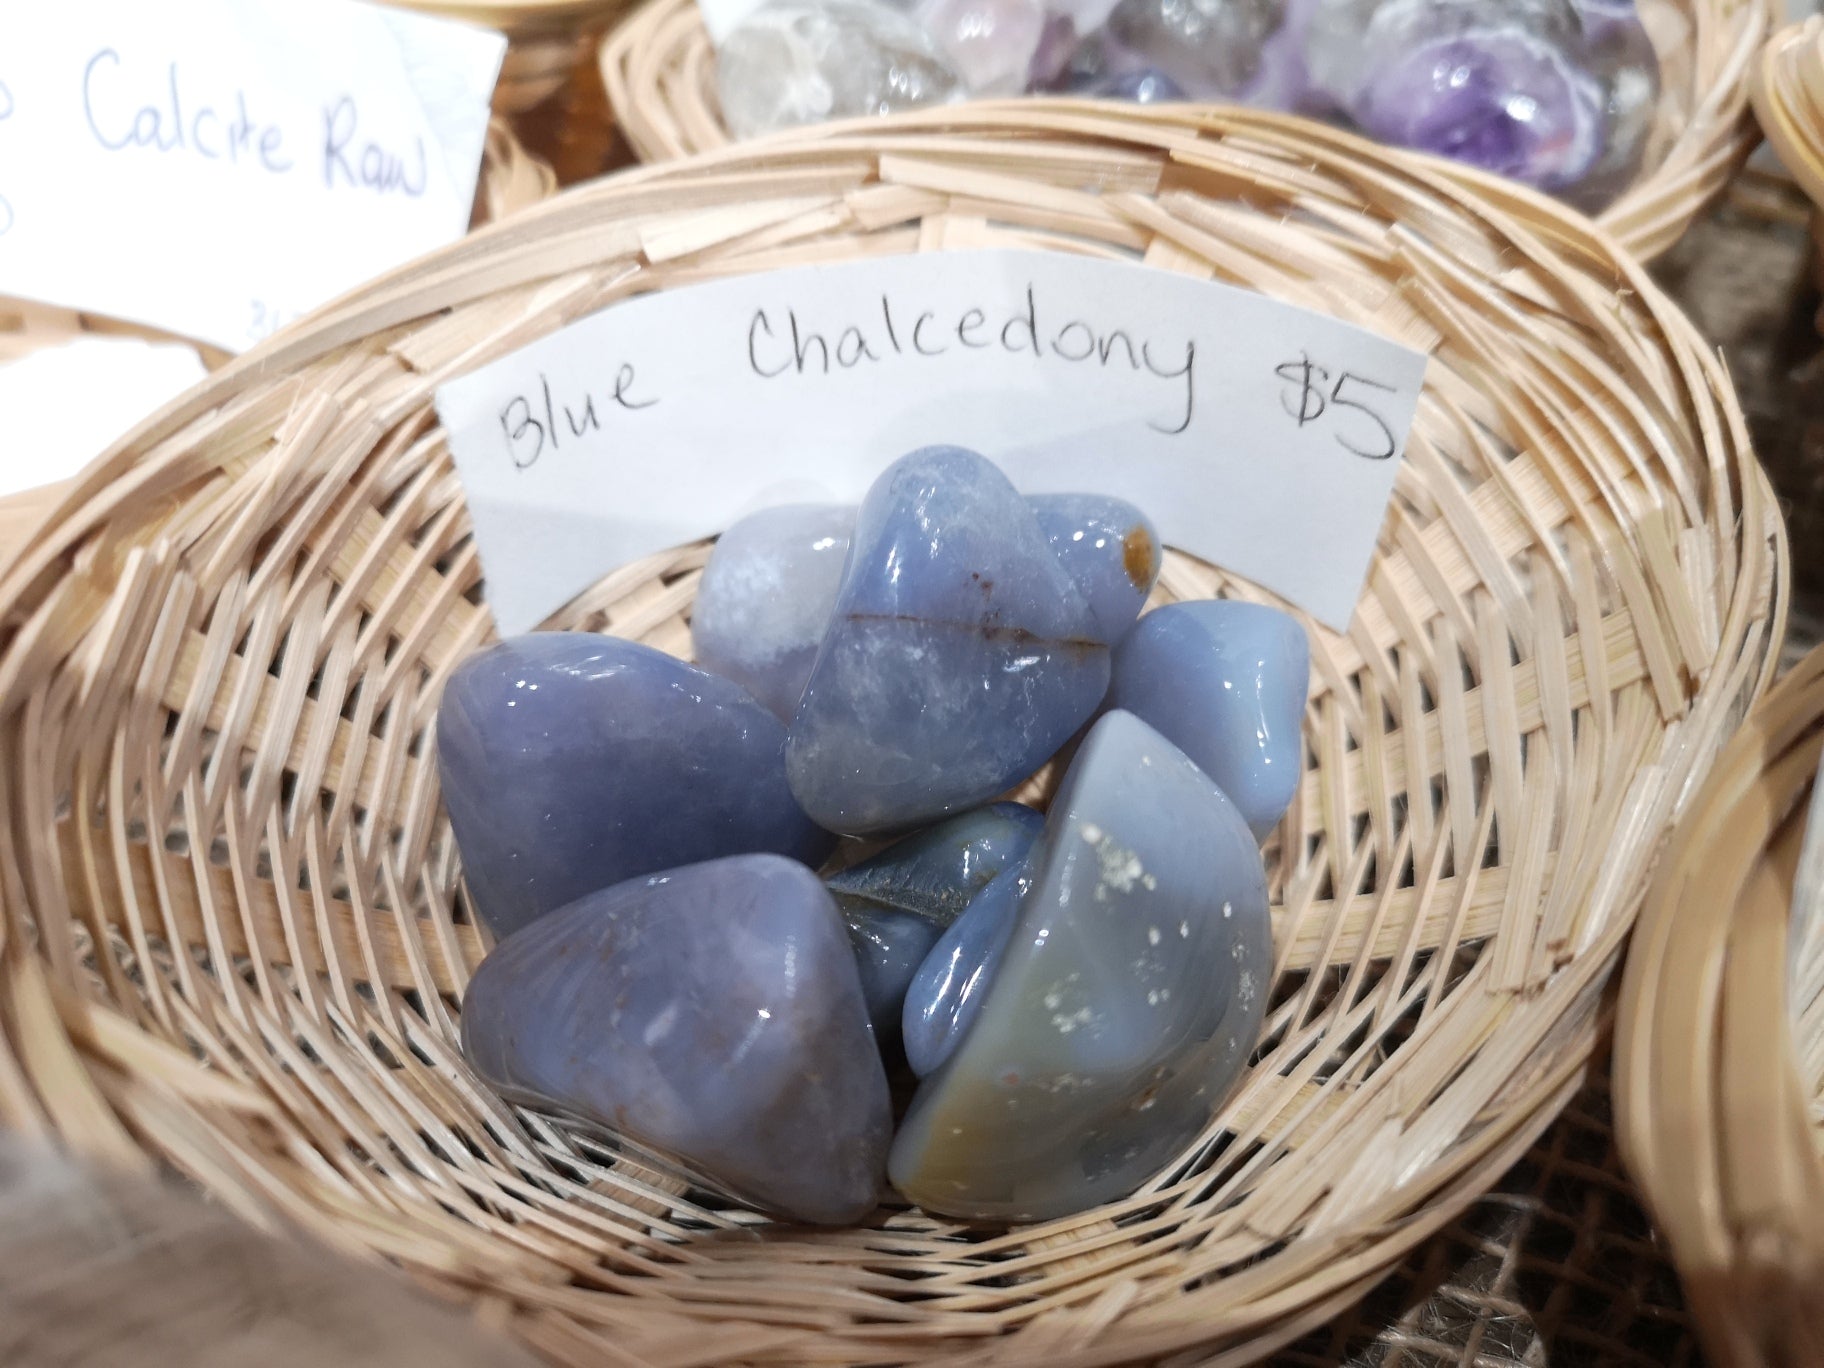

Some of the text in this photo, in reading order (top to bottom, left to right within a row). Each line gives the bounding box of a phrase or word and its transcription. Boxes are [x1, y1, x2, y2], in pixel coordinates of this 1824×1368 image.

[82, 46, 427, 198] Calcite Raw
[499, 282, 1398, 472] Blue Chalcedony $5
